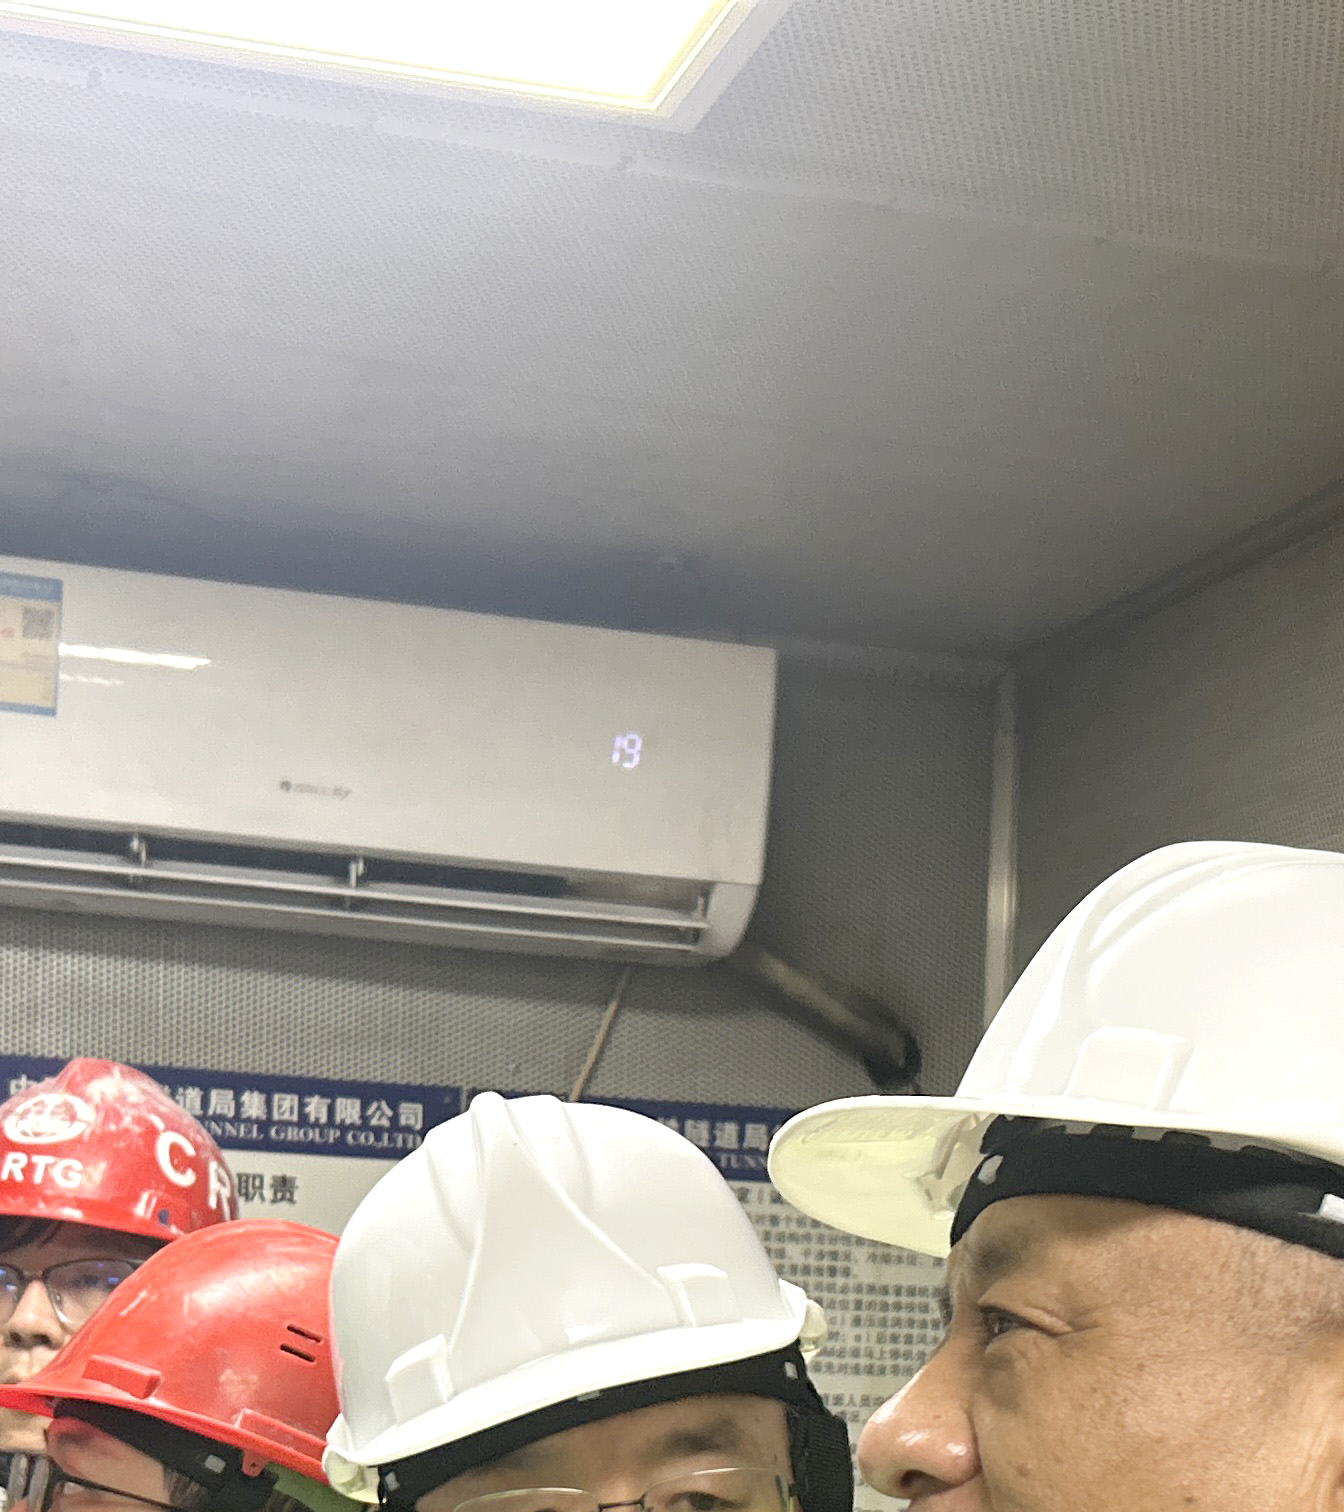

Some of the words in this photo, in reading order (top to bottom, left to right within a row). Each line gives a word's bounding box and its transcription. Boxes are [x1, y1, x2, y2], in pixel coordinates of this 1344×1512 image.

[612, 733, 643, 768] 19
[205, 1120, 265, 1140] NNEL
[270, 1124, 341, 1144] GROUP
[236, 1172, 299, 1205] 职责
